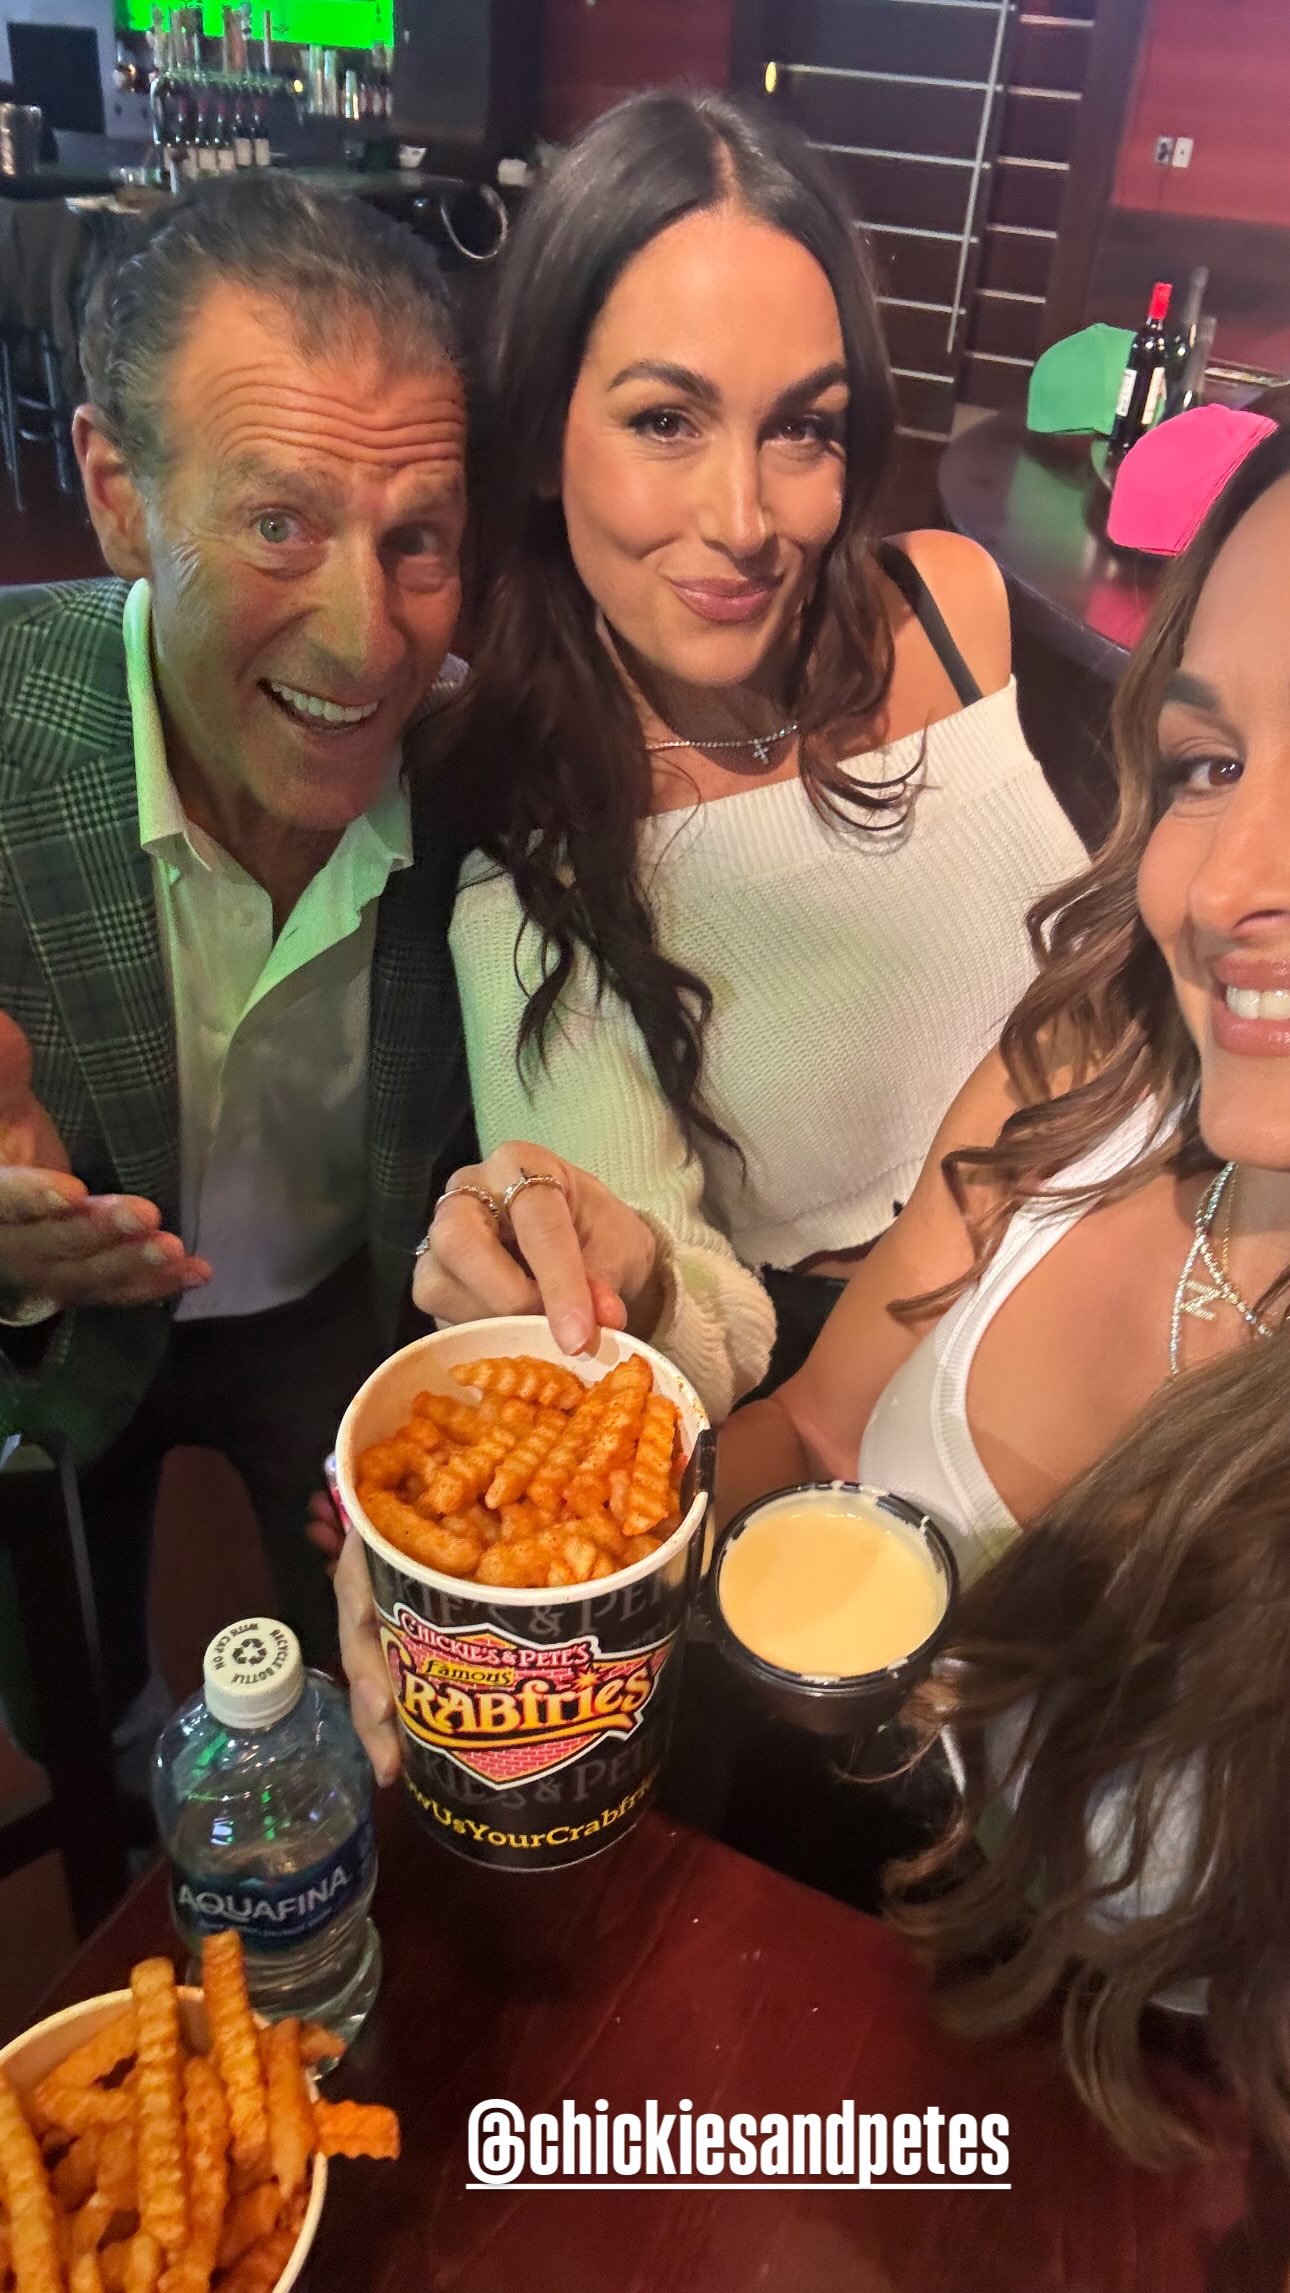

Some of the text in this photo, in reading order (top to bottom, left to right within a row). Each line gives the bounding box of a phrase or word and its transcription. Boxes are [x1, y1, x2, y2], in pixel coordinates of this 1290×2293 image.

[213, 1623, 258, 1670] WITH CAP ON
[231, 1629, 288, 1684] RECYCLE BOTTLE
[401, 1612, 591, 1667] CHICKIE'S & PETE'S
[425, 1659, 511, 1687] Famous
[178, 1865, 348, 1922] AQUAFINA
